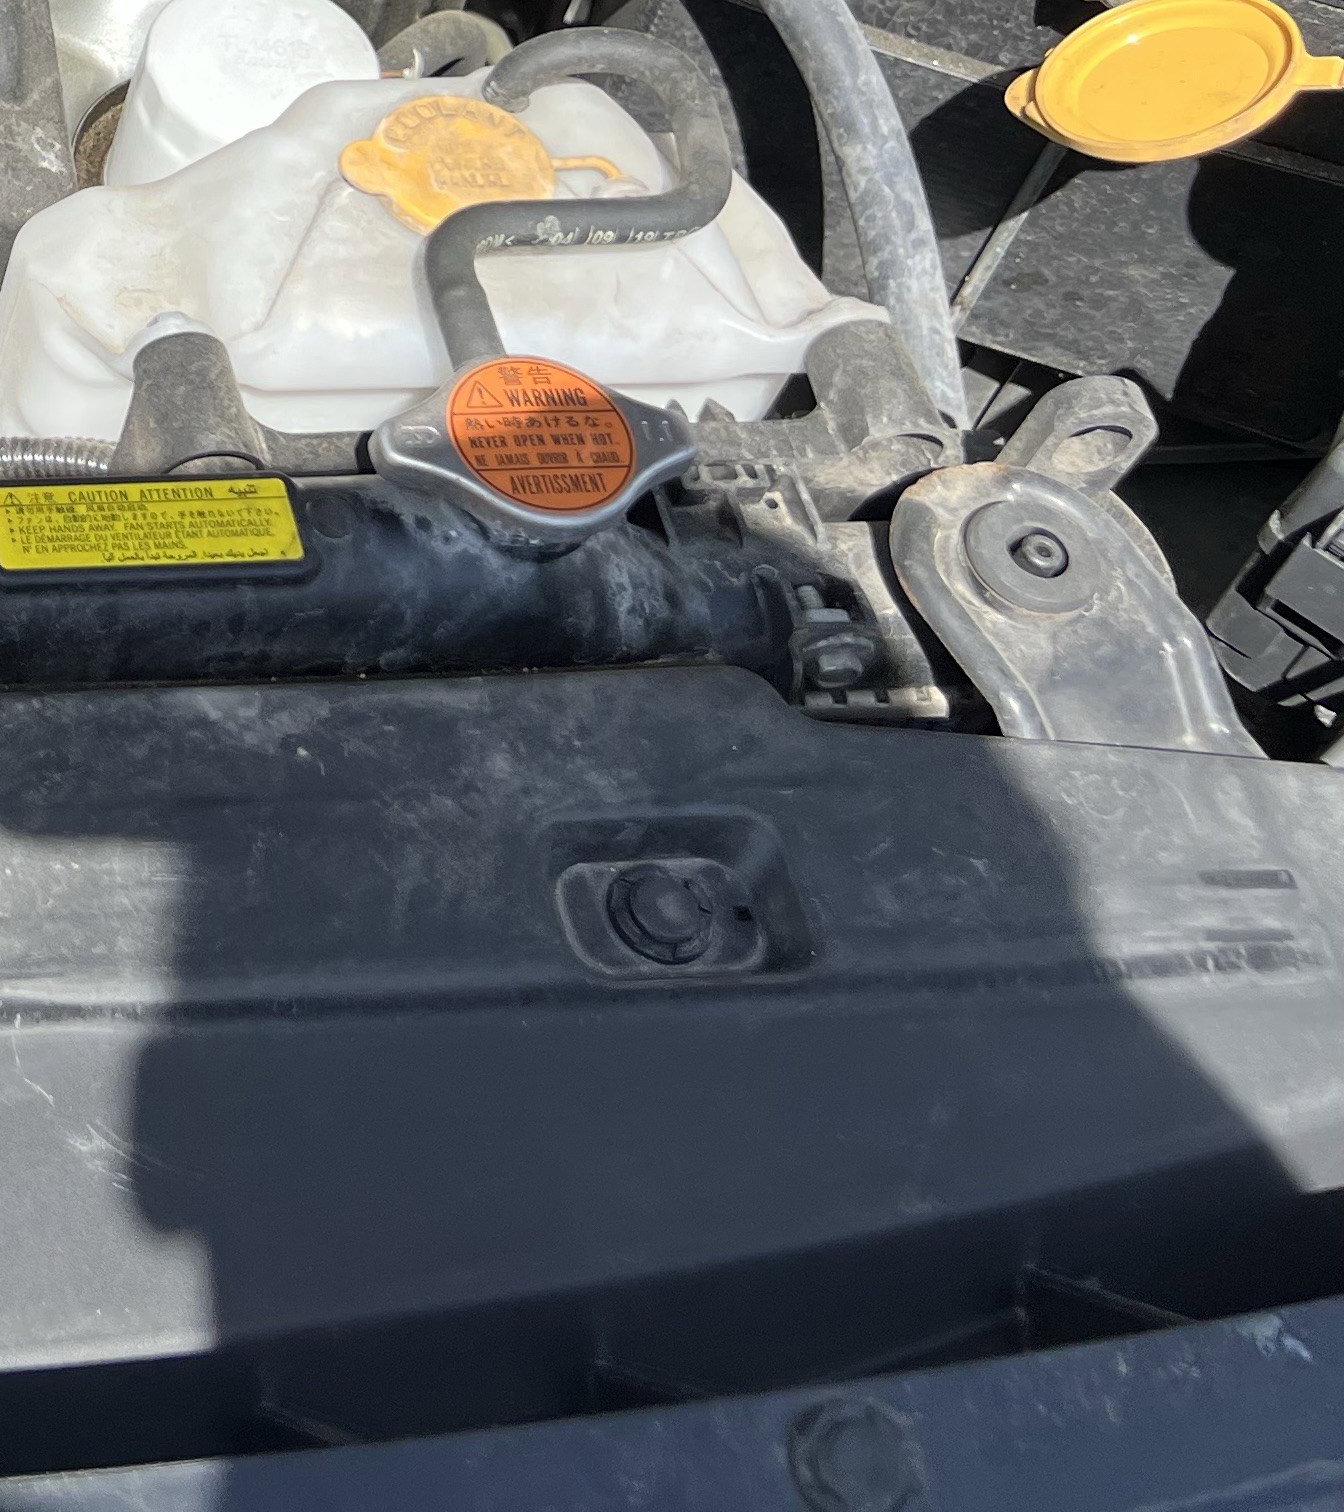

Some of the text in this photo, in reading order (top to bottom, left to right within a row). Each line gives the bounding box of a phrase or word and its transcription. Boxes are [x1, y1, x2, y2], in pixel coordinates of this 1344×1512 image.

[502, 387, 588, 407] WARNING
[468, 435, 508, 449] NEVER
[514, 433, 546, 447] OPEN
[550, 433, 585, 446] WHEN
[68, 487, 214, 503] CAUTION ATTENTION
[18, 525, 46, 535] KEEP
[49, 524, 85, 534] HANDS
[124, 521, 144, 531] FAN
[147, 520, 185, 530] STARTS
[20, 535, 31, 544] LE
[95, 533, 108, 542] DU
[109, 529, 172, 542] VENTILATEUR
[51, 543, 109, 554] APPROCHEZ
[112, 542, 130, 552] PAS
[133, 542, 151, 551] LES
